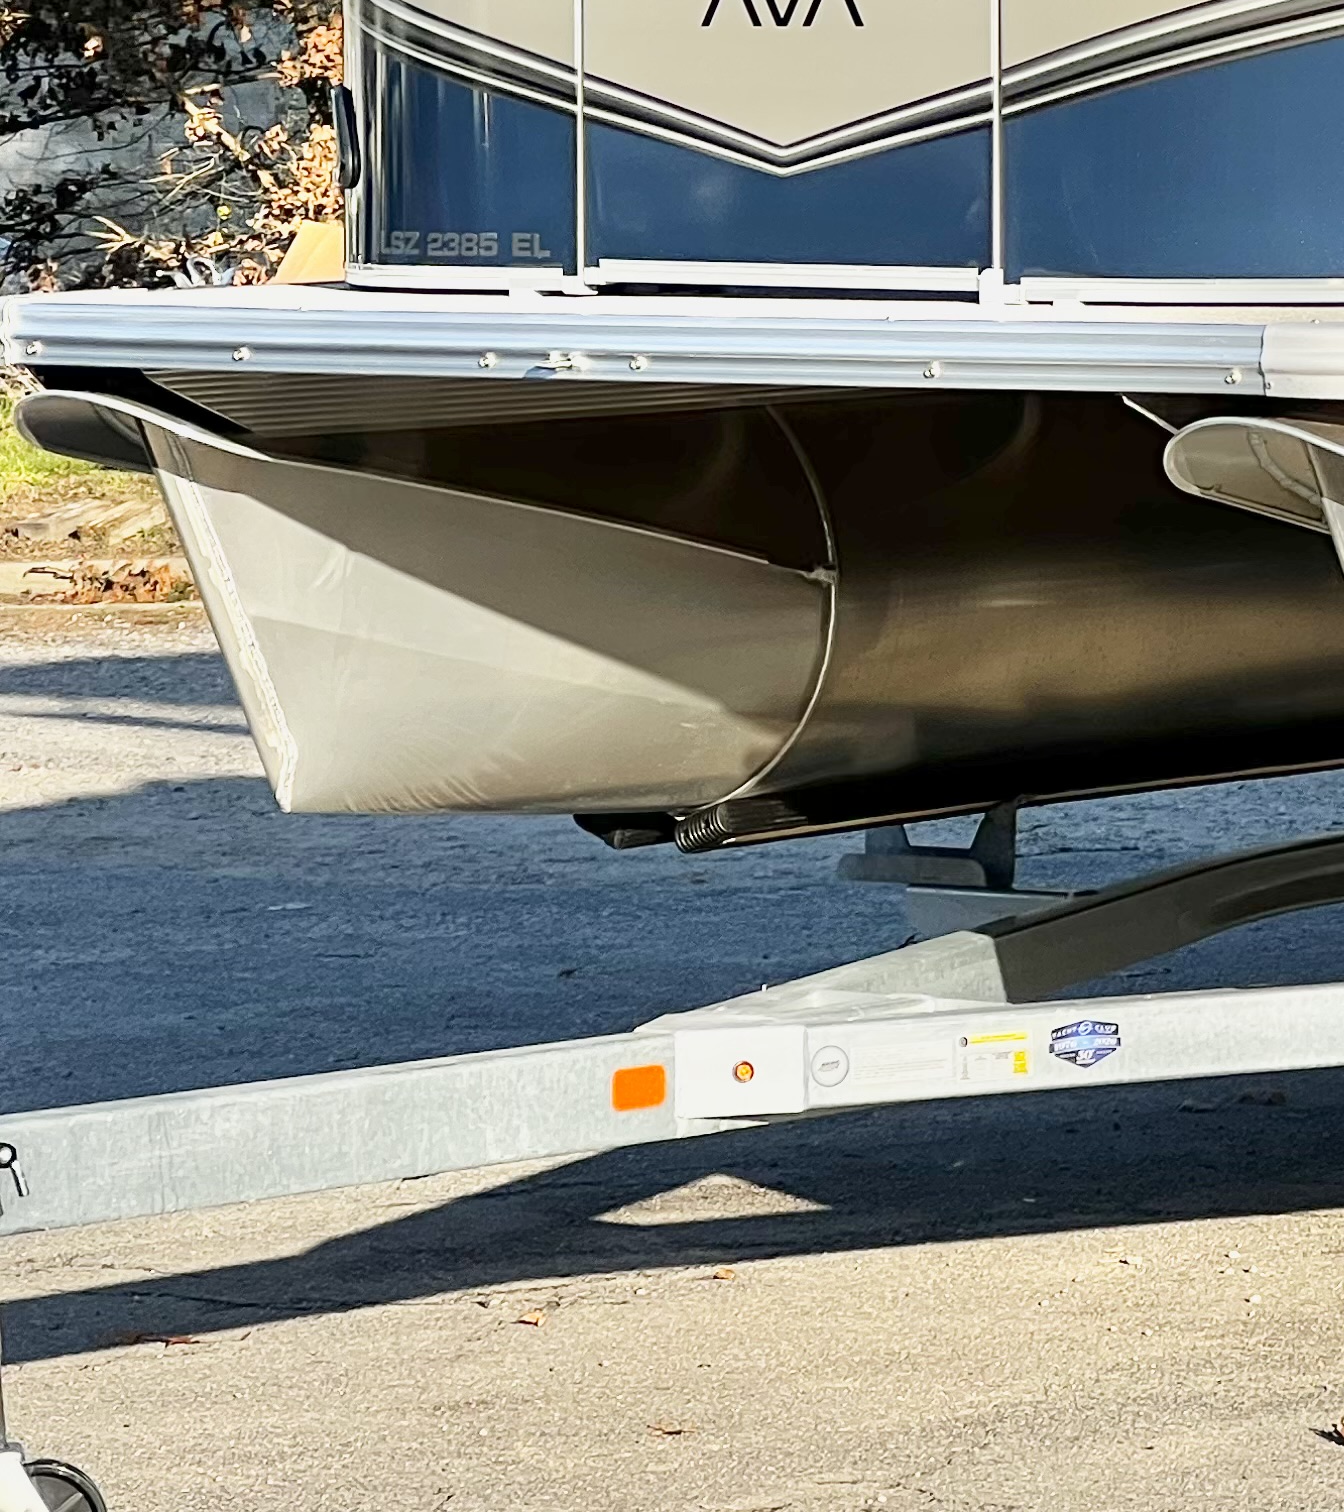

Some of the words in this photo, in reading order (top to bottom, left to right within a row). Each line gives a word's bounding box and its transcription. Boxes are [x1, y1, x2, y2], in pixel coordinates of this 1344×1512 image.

[381, 231, 420, 255] LSZ
[427, 232, 499, 257] 2385
[512, 232, 551, 258] EL
